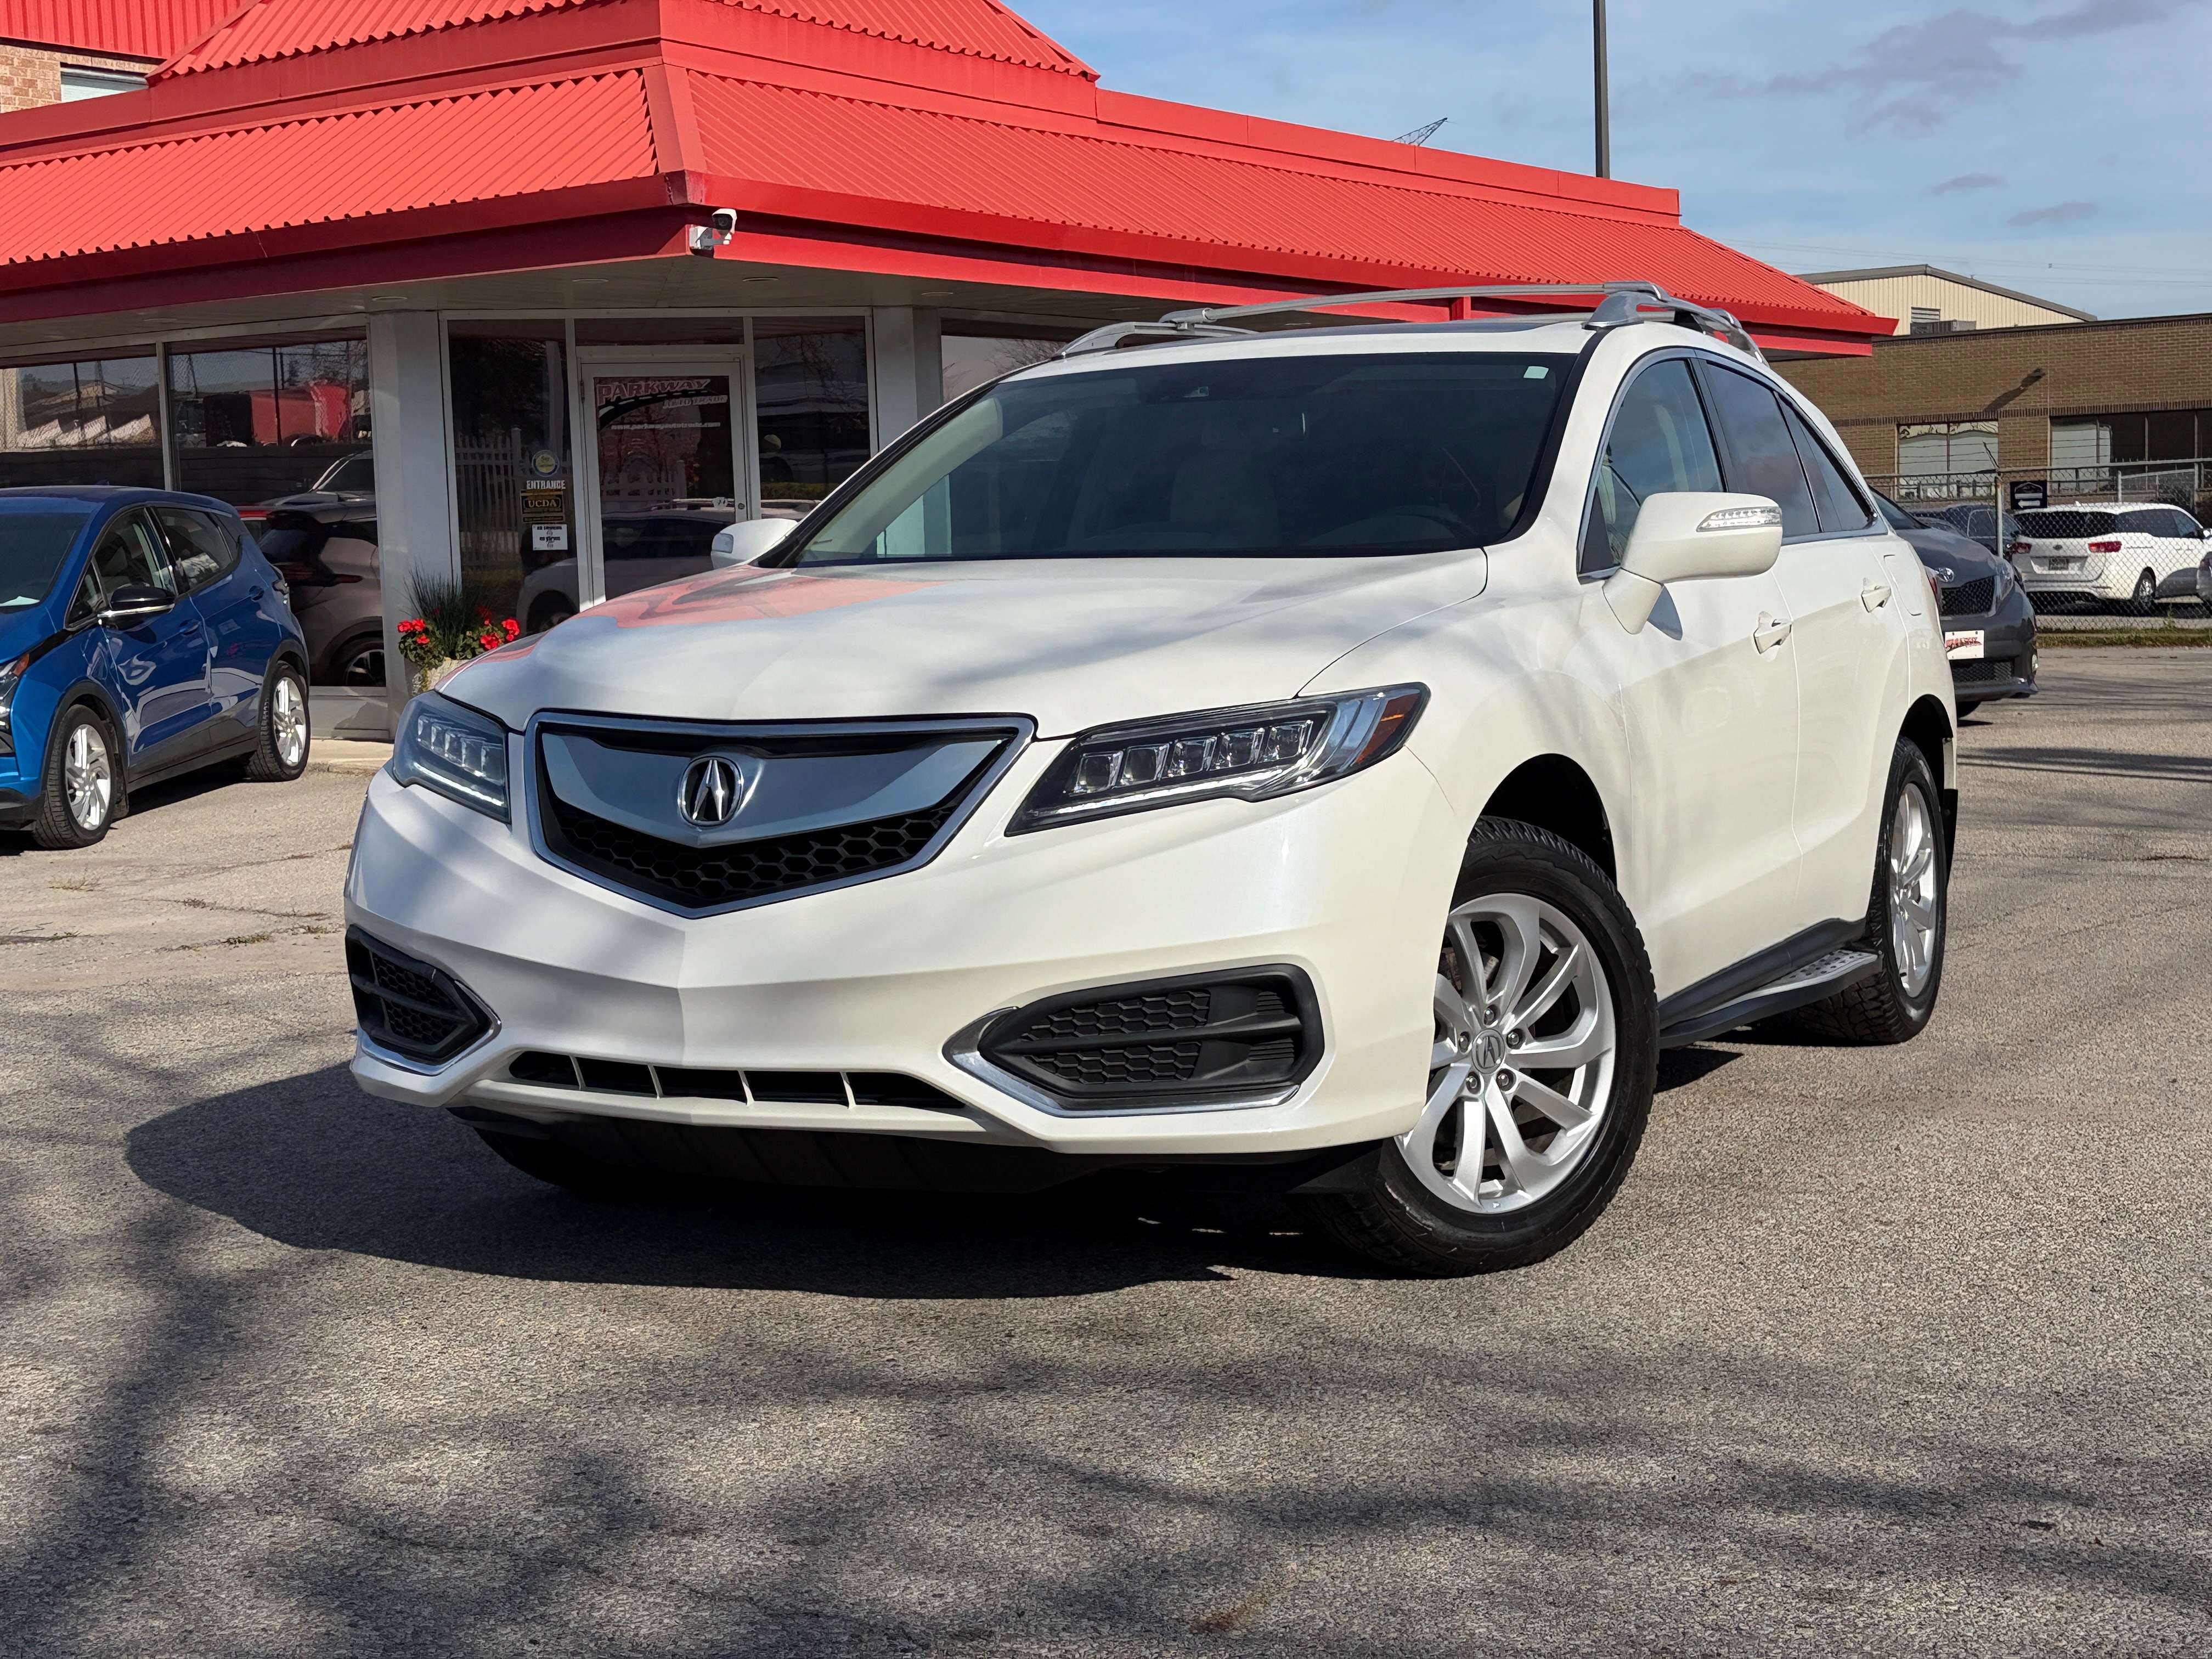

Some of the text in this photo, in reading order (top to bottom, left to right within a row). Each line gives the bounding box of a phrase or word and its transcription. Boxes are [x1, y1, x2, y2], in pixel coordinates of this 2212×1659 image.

[596, 379, 711, 407] PARKWAY
[527, 480, 566, 489] ENTRANCE
[528, 499, 557, 507] UCDA
